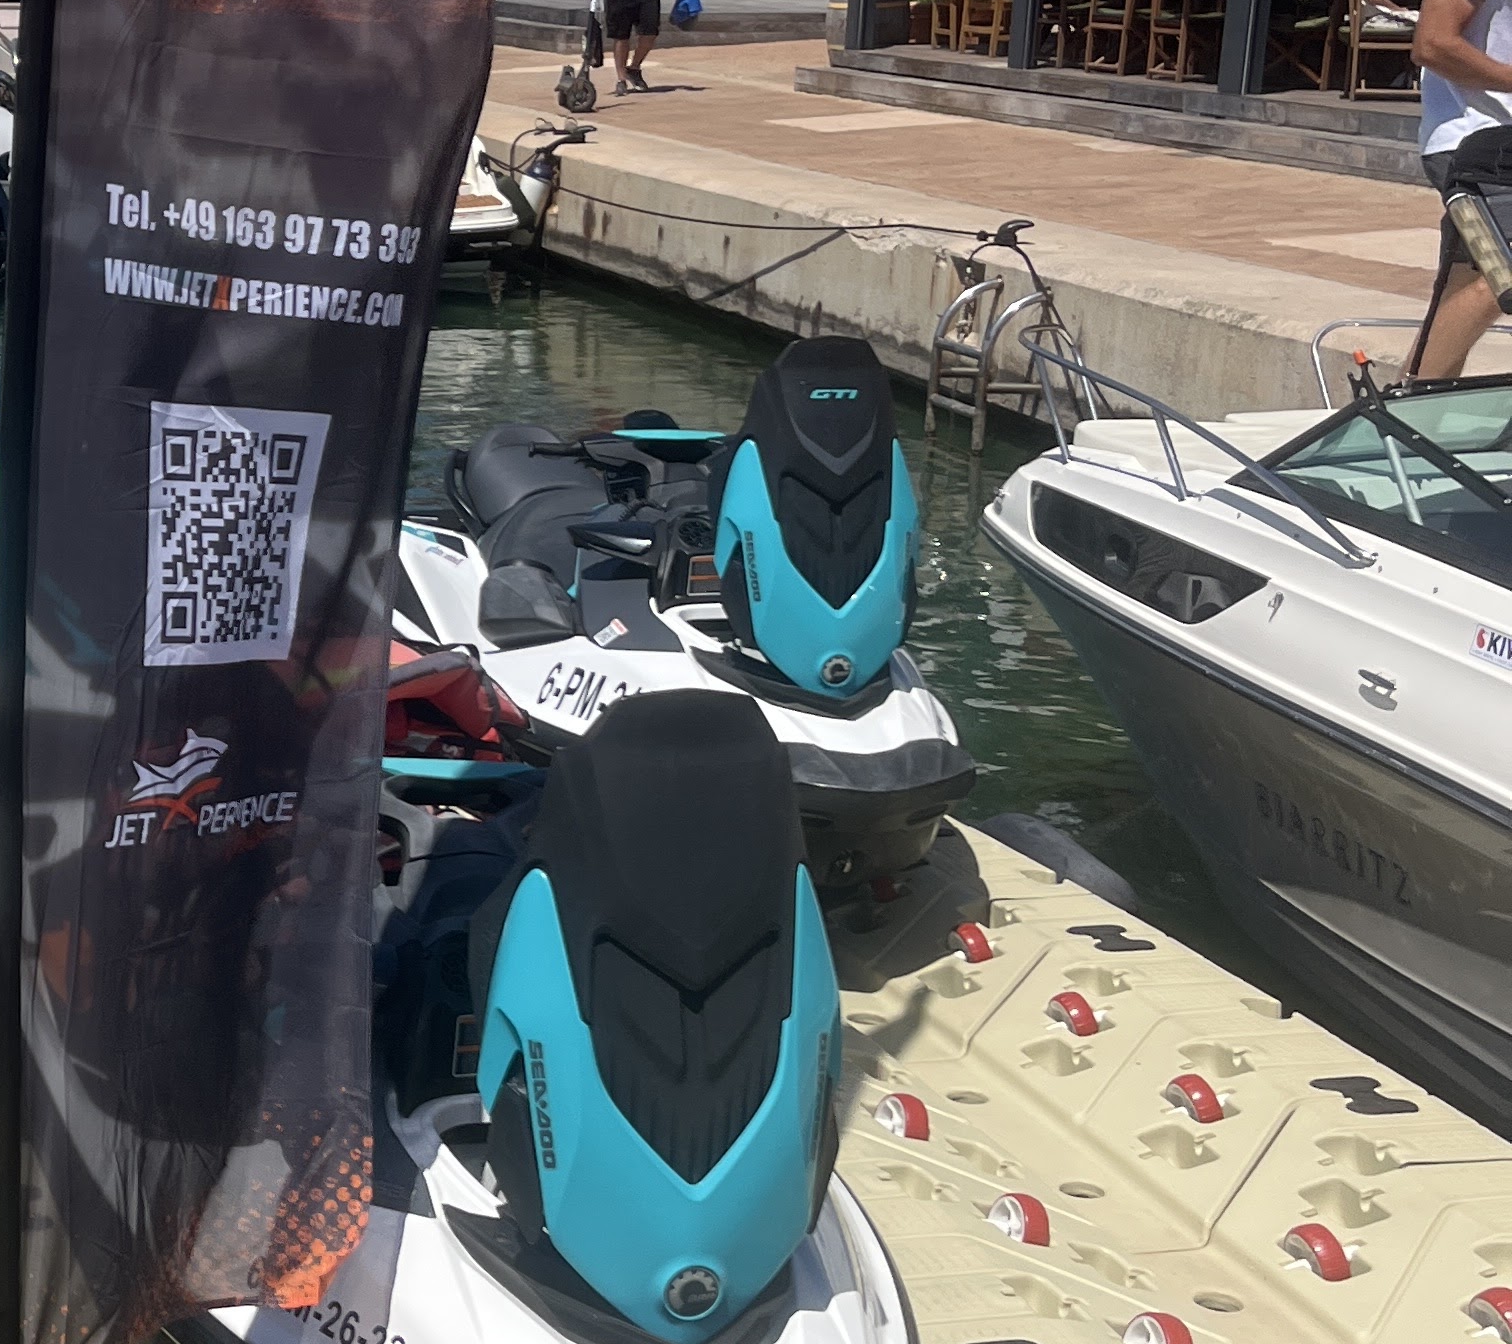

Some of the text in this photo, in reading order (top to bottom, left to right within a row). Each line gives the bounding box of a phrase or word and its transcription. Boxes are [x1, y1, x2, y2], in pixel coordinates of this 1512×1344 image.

[105, 183, 156, 231] Tel.
[163, 198, 217, 242] +49
[222, 205, 277, 250] 163
[284, 213, 324, 255] 97
[331, 219, 371, 260] 73
[810, 388, 858, 400] GTI
[536, 661, 643, 721] 6-PM-2
[104, 812, 157, 849] JET
[1255, 780, 1412, 906] BIARRITZ
